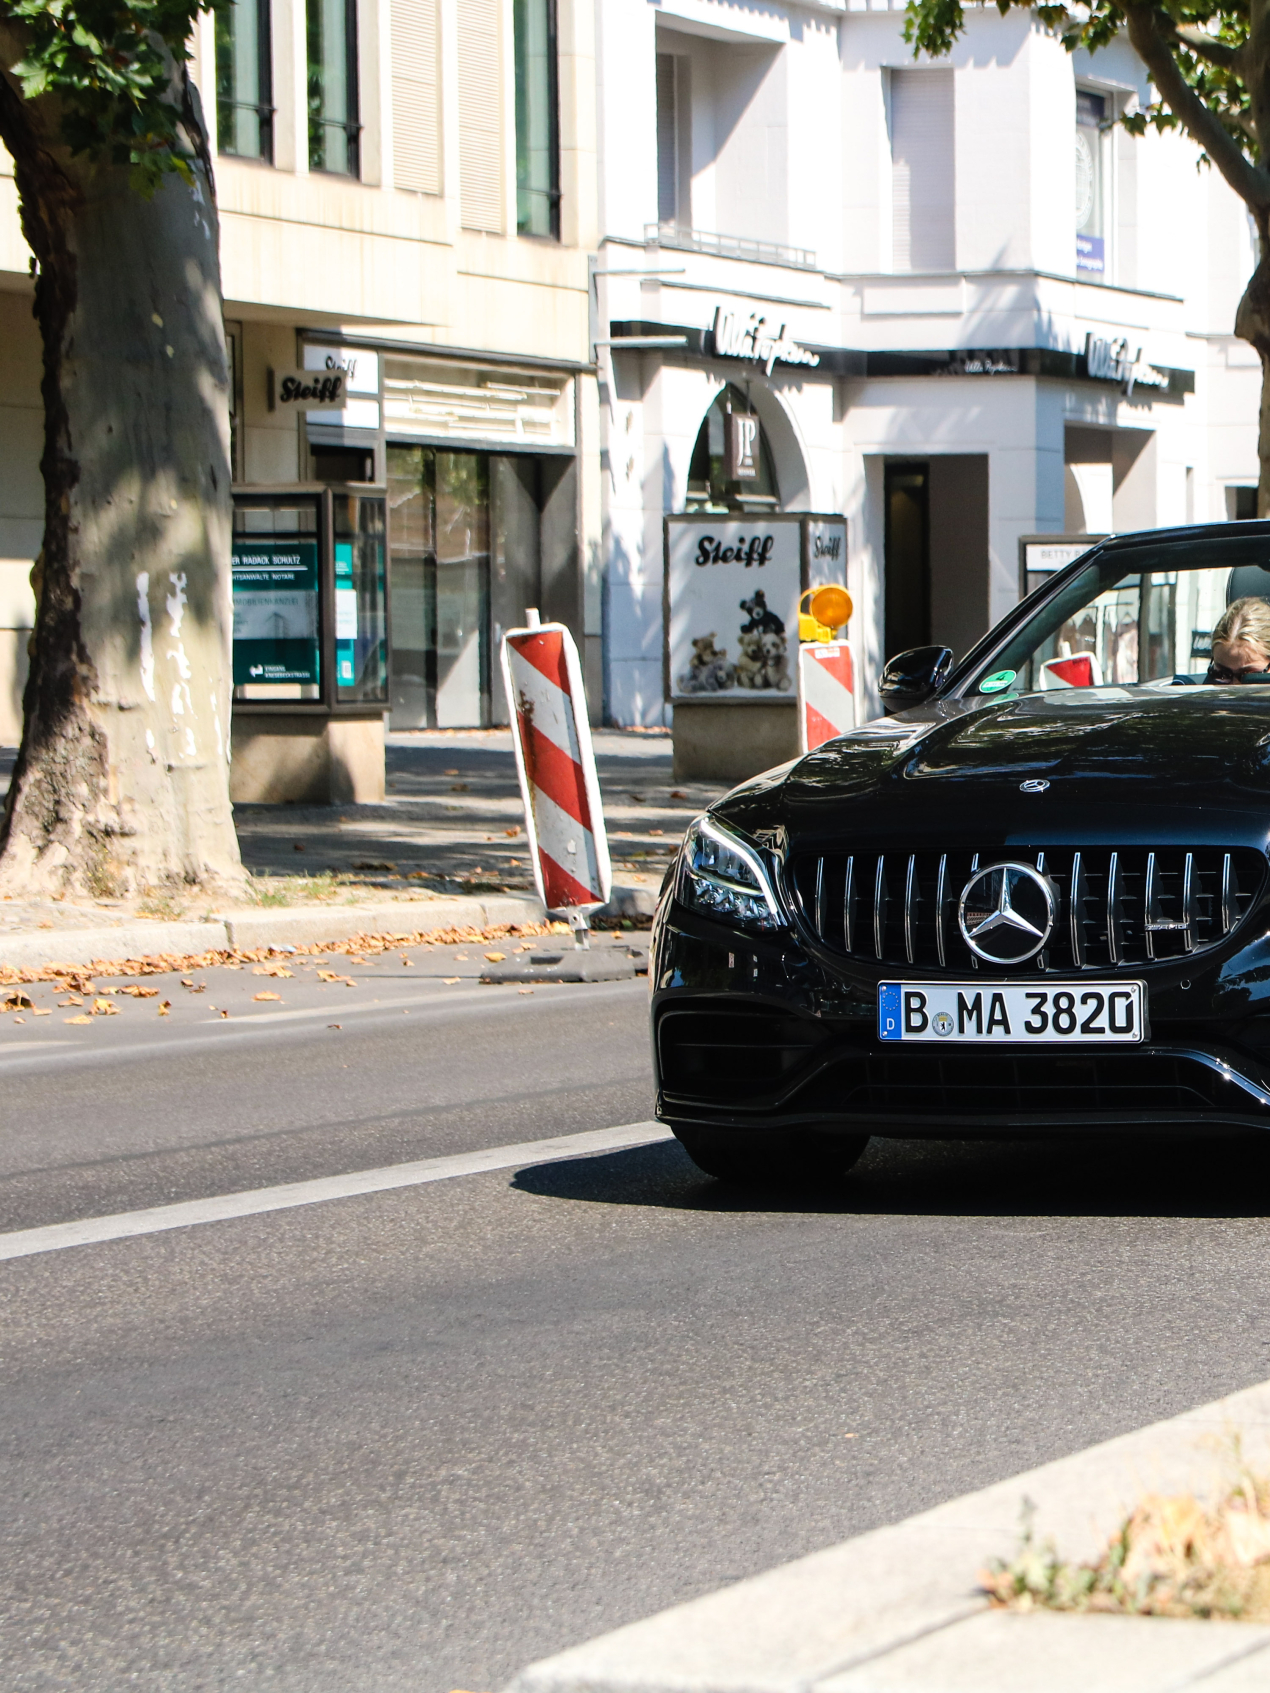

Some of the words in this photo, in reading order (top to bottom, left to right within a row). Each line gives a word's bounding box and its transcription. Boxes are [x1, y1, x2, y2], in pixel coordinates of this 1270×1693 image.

[281, 376, 342, 403] Steiff
[231, 555, 240, 565] ER
[272, 554, 301, 565] SCHULTZ
[695, 535, 775, 568] Steiff
[814, 536, 841, 561] Steiff
[886, 1018, 895, 1031] D
[904, 991, 930, 1034] B
[957, 991, 1011, 1035] MA
[1023, 991, 1135, 1034] 3820
